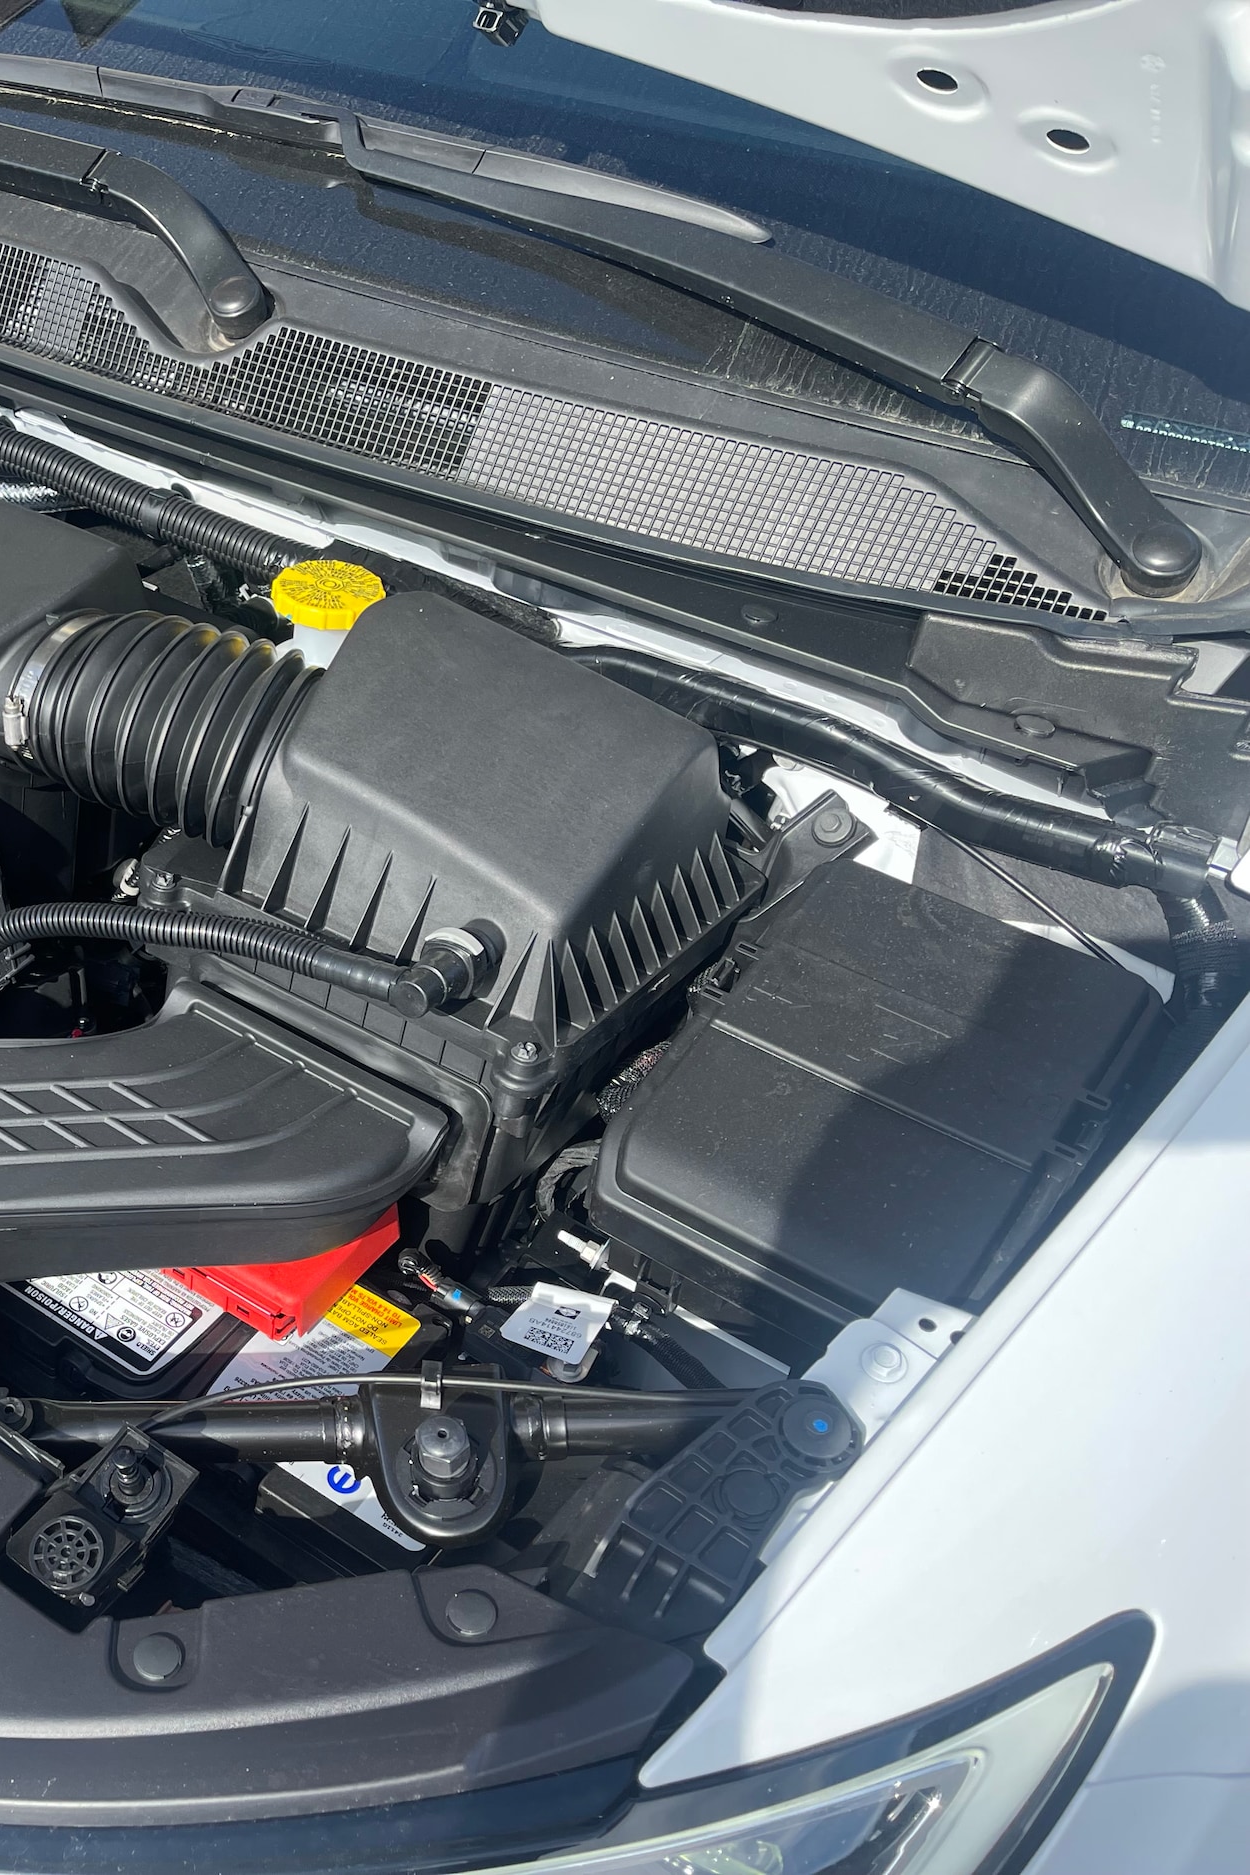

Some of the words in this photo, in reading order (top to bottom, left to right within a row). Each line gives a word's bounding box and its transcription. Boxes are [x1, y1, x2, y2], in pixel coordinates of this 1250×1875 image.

[40, 1279, 65, 1297] SULFURIC
[57, 1282, 70, 1292] ACID
[357, 1292, 377, 1305] VOLTS
[23, 1285, 95, 1333] DANGER/POISON
[359, 1300, 384, 1317] CHARGE
[377, 1304, 391, 1313] 14.4
[119, 1314, 138, 1327] GASES
[342, 1316, 359, 1328] AGM
[351, 1314, 366, 1324] NOT
[383, 1314, 402, 1327] LIMIT
[366, 1322, 378, 1332] DO
[137, 1325, 166, 1345] EXPLOSIVE
[358, 1326, 387, 1344] SEALED
[135, 1341, 156, 1356] SHIELD
